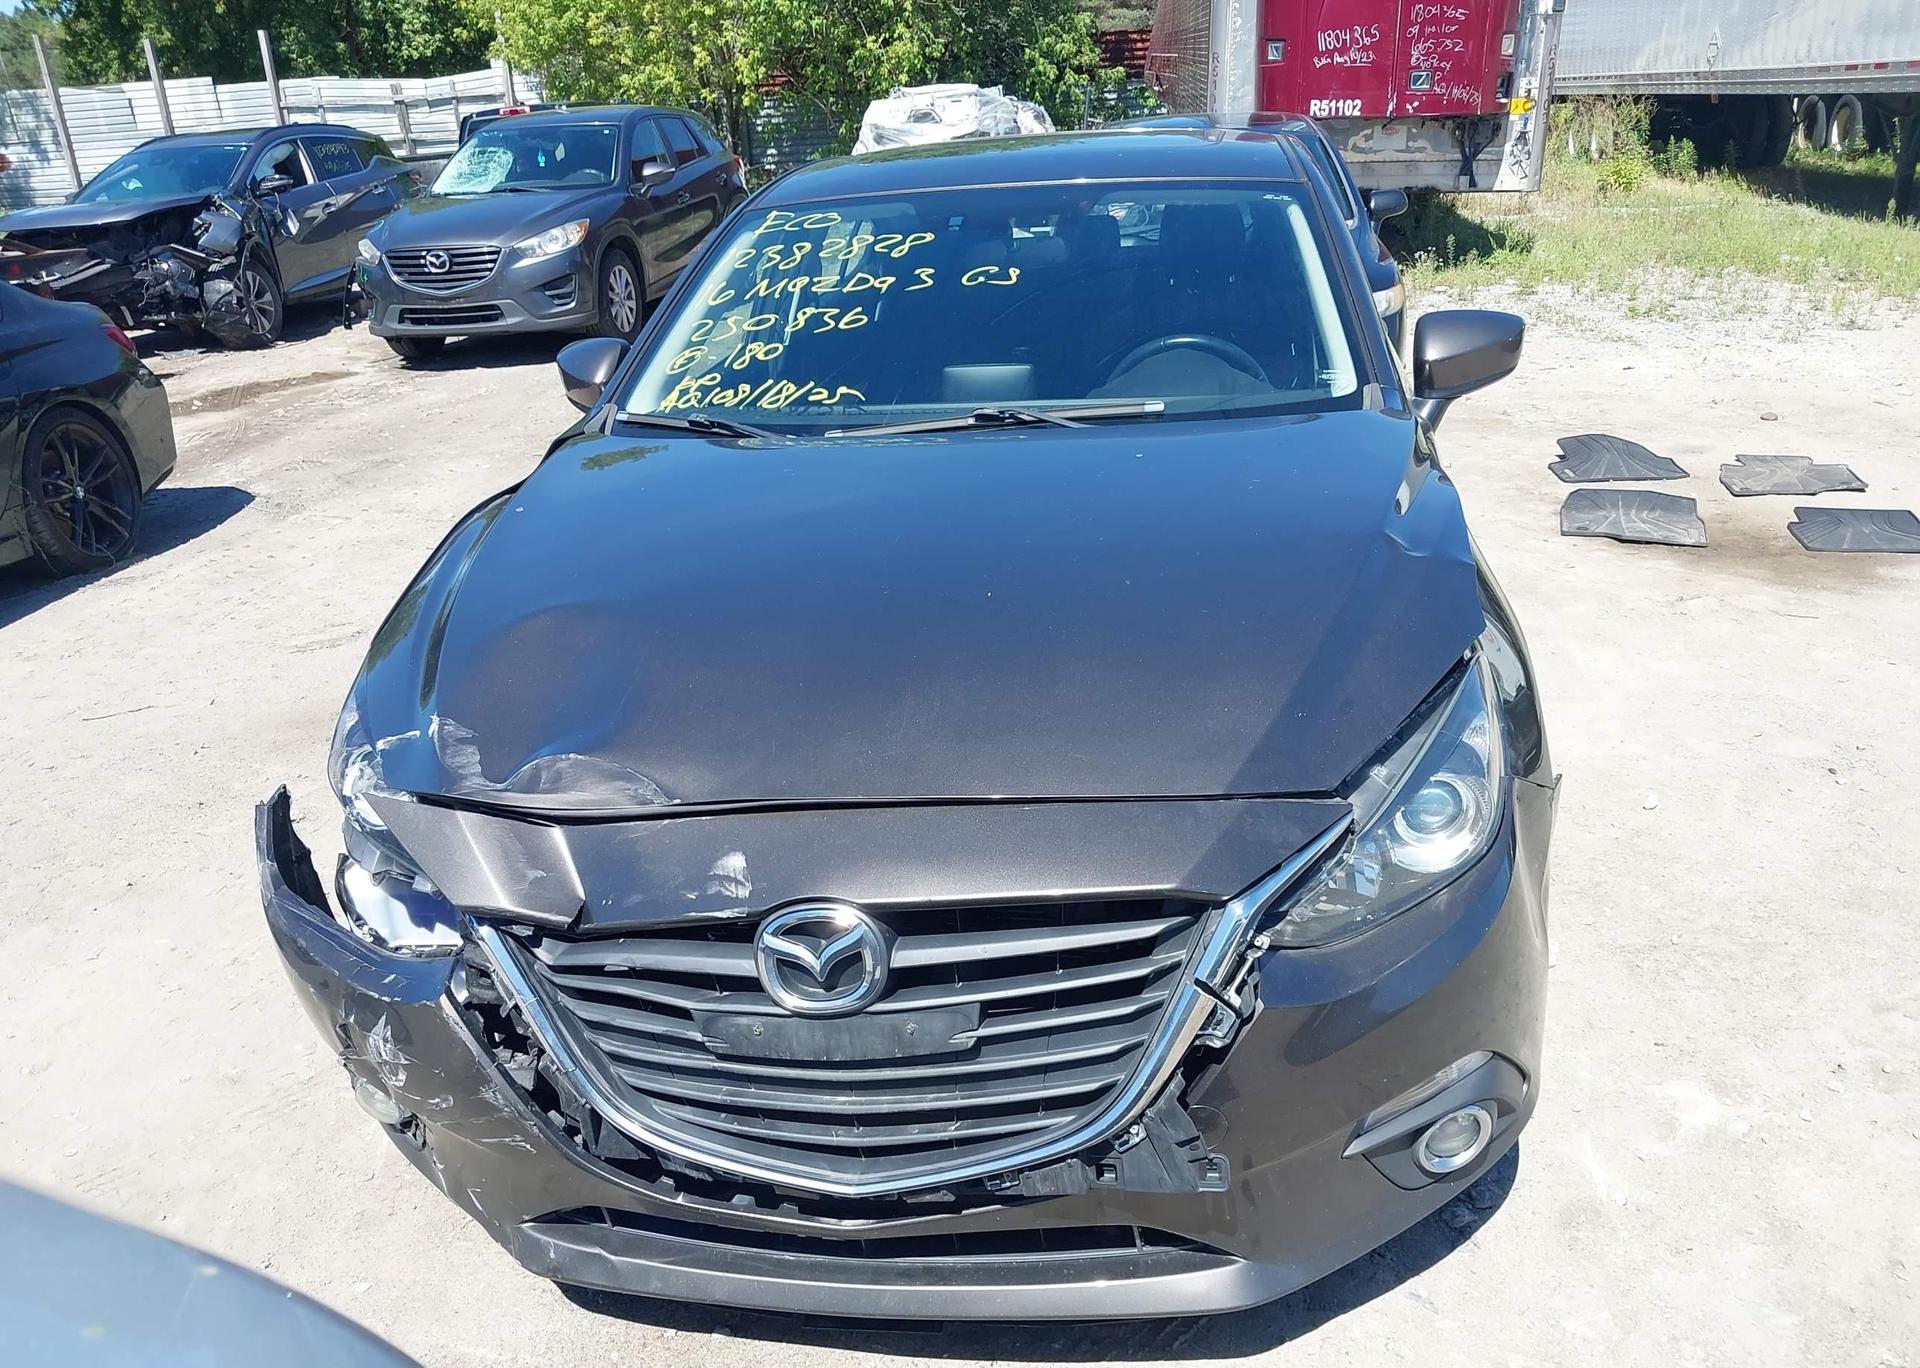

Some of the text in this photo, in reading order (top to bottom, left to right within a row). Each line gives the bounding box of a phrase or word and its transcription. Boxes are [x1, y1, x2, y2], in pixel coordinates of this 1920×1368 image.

[1318, 24, 1379, 51] 11804365
[1310, 98, 1362, 117] R51102
[752, 210, 842, 239] ECO
[904, 268, 936, 291] 3
